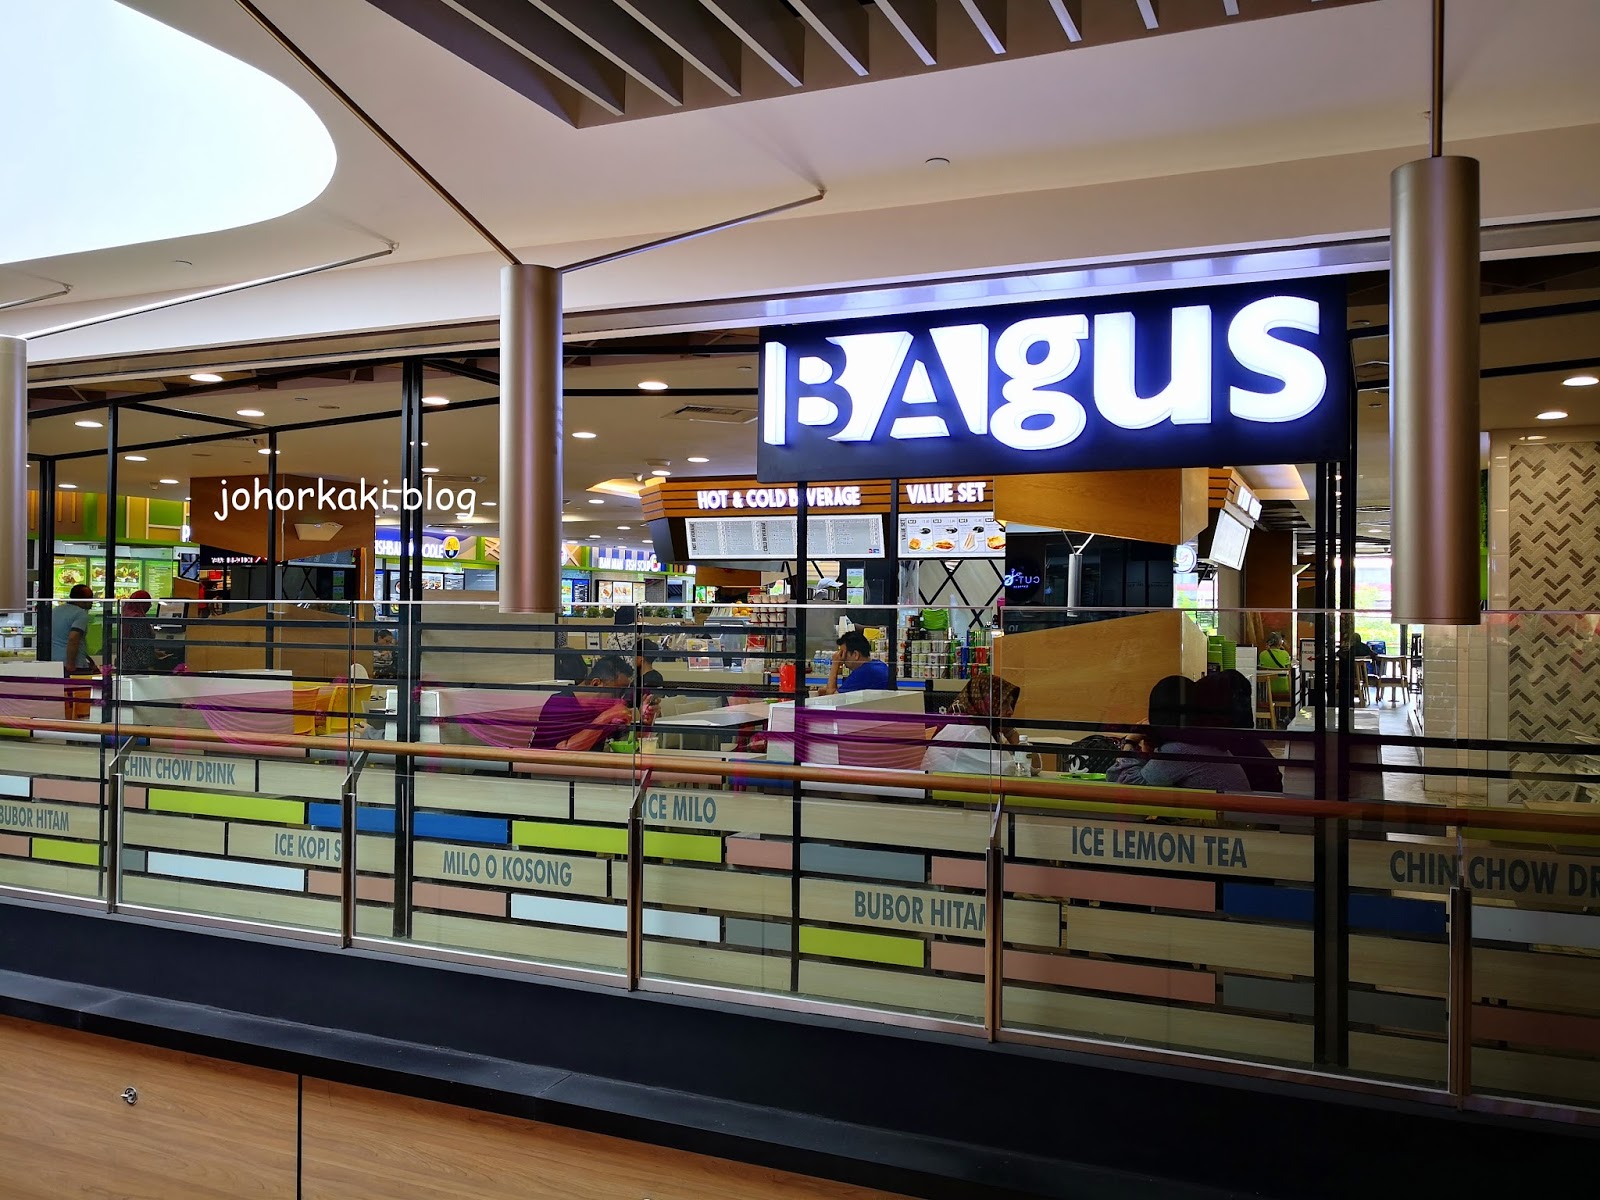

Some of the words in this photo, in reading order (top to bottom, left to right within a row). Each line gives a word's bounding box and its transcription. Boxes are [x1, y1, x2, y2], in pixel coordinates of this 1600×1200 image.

[696, 490, 729, 509] HOT
[732, 490, 745, 509] &
[745, 488, 788, 509] COLD
[788, 486, 862, 508] BVERAGE
[906, 483, 954, 504] VALUE
[957, 481, 987, 503] SET
[124, 756, 152, 778] CHIN
[156, 758, 193, 781] CHOW
[196, 761, 235, 785] DRINK
[0, 804, 33, 827] BUBOR
[36, 809, 69, 832] HITAM
[643, 793, 667, 819] ICE
[673, 795, 717, 824] MILO
[275, 833, 294, 857] ICE
[298, 836, 330, 860] KOPI
[1072, 826, 1104, 857] ICE
[1113, 829, 1195, 864] LEMON
[1204, 835, 1248, 868] TEA
[443, 850, 480, 877] MILO
[485, 854, 498, 879] O
[502, 856, 572, 887] KOSONG
[1390, 850, 1458, 885] CHIN
[1469, 856, 1558, 894] CHOW
[855, 890, 923, 925] BUBOR
